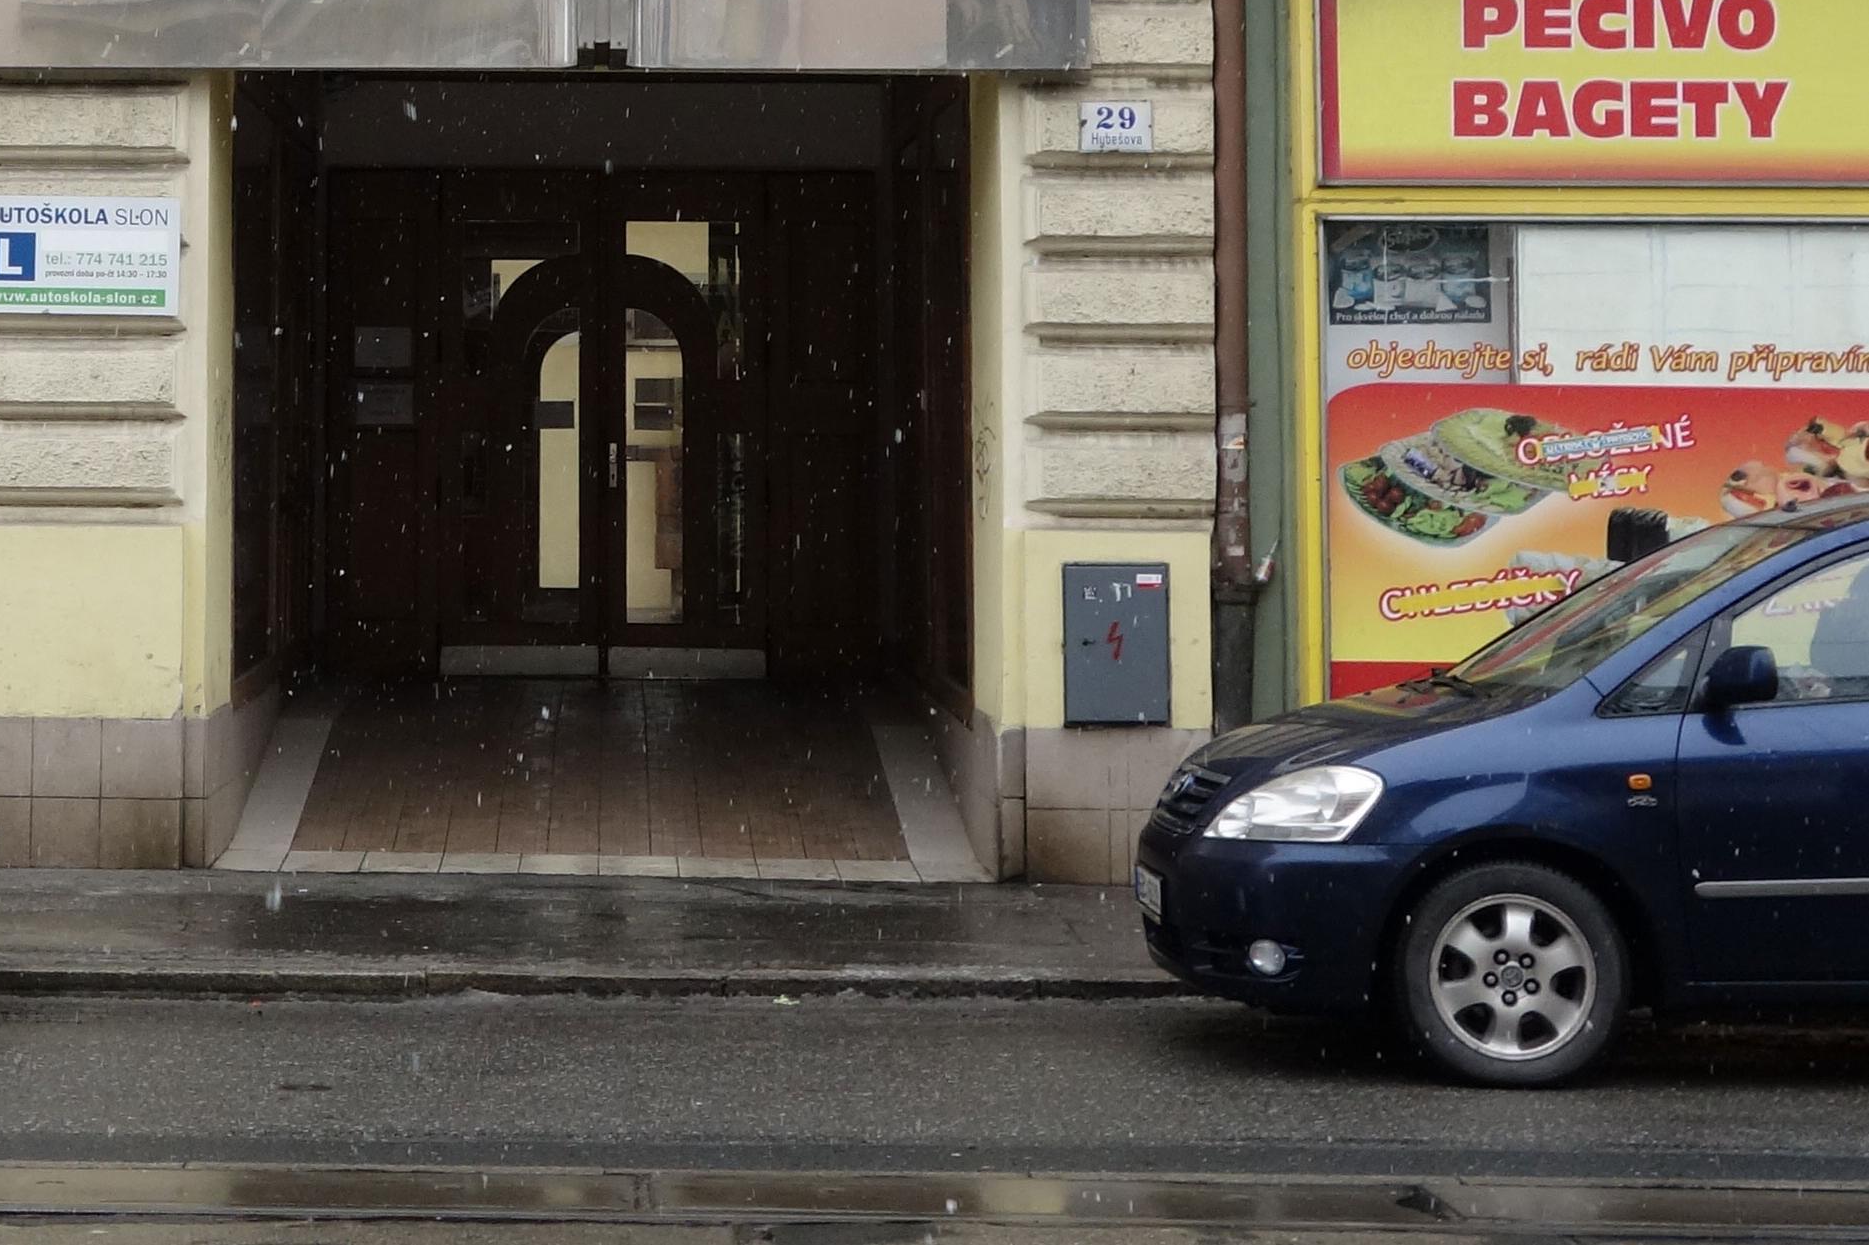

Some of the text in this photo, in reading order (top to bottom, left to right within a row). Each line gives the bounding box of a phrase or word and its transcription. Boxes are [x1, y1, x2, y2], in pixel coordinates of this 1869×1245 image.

[1096, 106, 1136, 129] 29
[1451, 78, 1790, 140] BAGETY
[1091, 132, 1142, 148] Hybešova
[114, 208, 169, 226] SLON
[0, 238, 22, 275] L
[46, 252, 168, 266] tel.: 774 741 215
[76, 270, 94, 278] doba
[116, 270, 137, 278] 14:30
[1347, 339, 1511, 379] objednejte
[1520, 343, 1554, 376] si,
[1576, 342, 1639, 372] rádi
[1650, 344, 1719, 372] Vám
